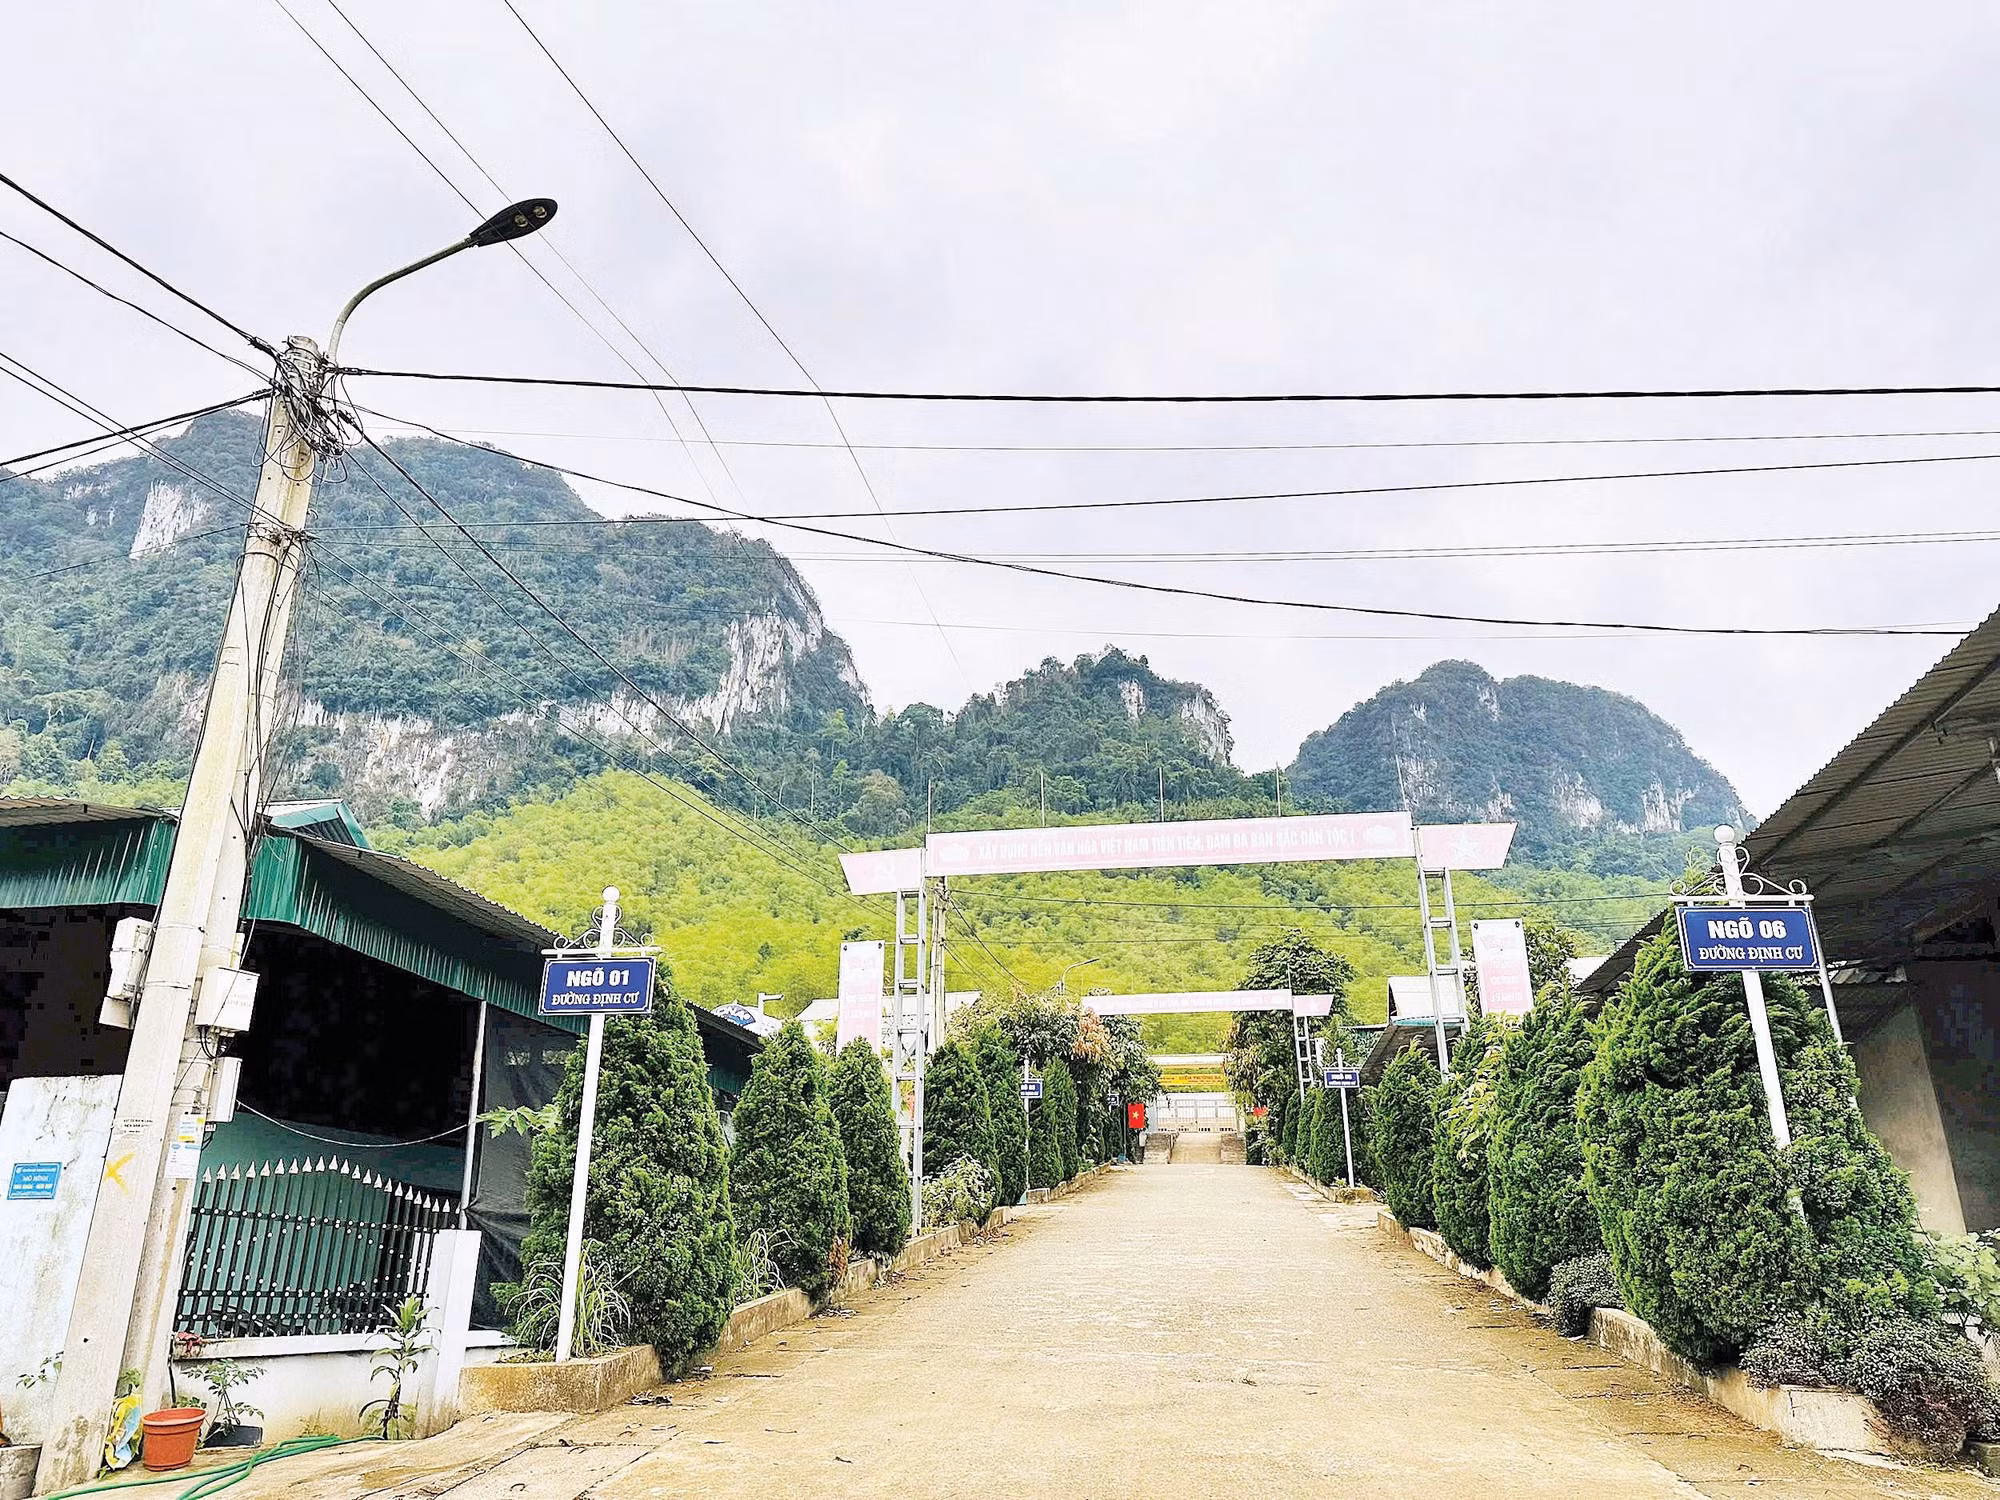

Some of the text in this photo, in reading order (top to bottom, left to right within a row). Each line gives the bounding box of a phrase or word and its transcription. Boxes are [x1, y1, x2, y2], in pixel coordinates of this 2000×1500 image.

[1707, 916, 1787, 939] NGÕ 06
[1698, 944, 1804, 963] ĐƯỜNG ĐỊNH CƯ
[566, 966, 630, 987] NGÕ 01
[551, 991, 640, 1007] ĐƯỜNG ĐỊNH CƯ
